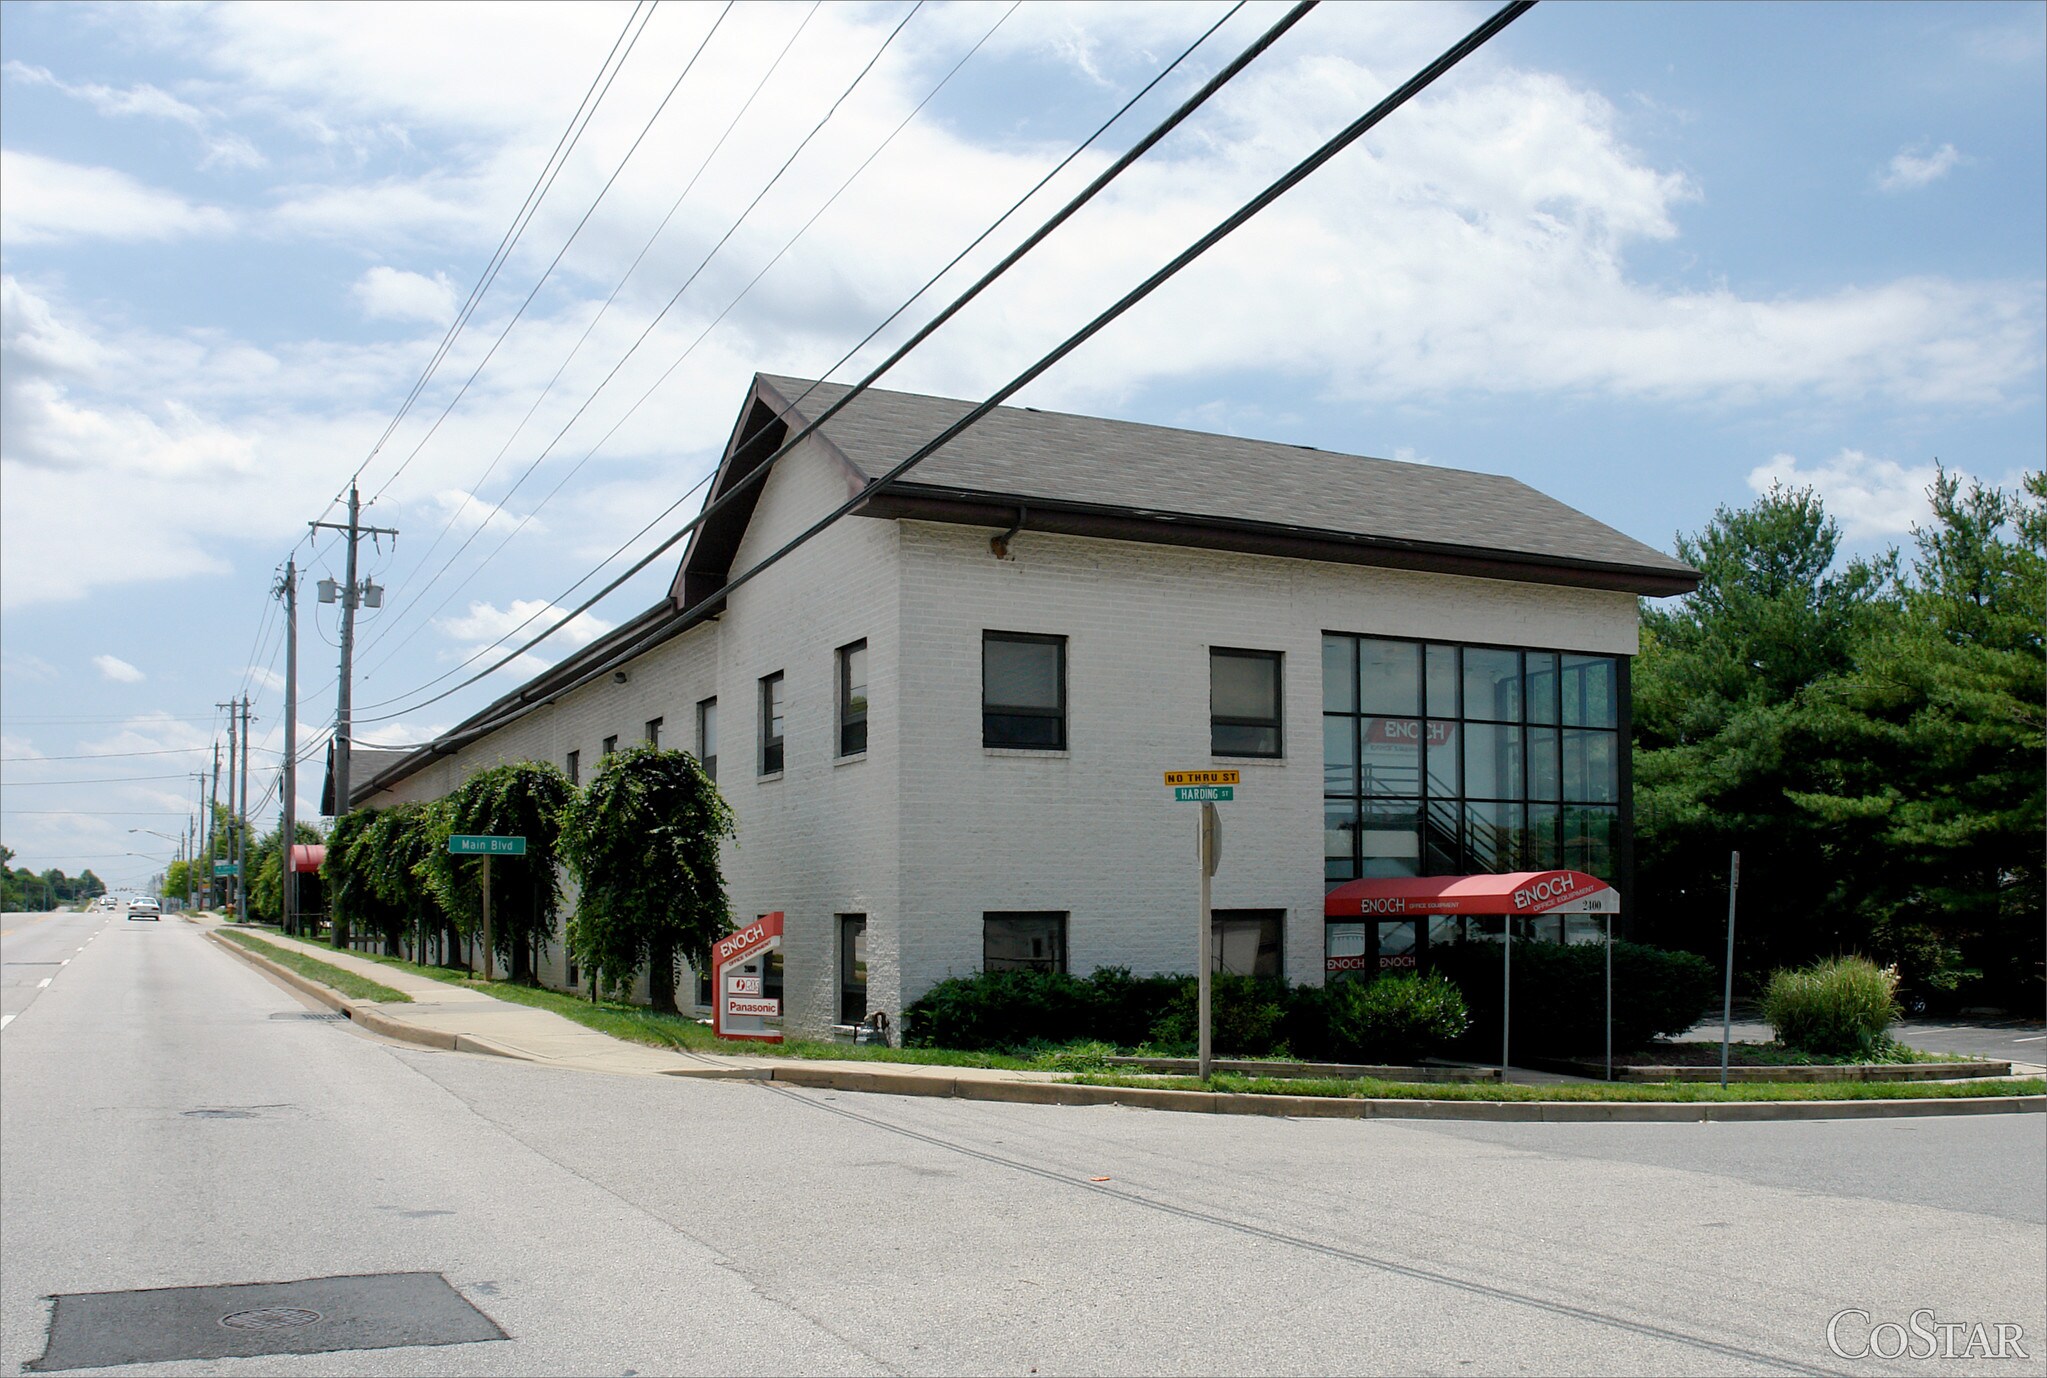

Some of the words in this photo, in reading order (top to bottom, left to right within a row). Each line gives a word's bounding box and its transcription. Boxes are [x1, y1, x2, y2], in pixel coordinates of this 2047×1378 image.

[1167, 774, 1183, 783] NO
[1188, 773, 1218, 782] THRU
[1223, 773, 1236, 781] ST
[1181, 788, 1218, 800] HARDING
[461, 839, 486, 850] Main
[491, 840, 513, 851] Blvd
[1514, 873, 1574, 909] ENOCH
[1533, 898, 1556, 912] OFFICE
[1556, 885, 1595, 903] EQUIPMENT
[1361, 897, 1405, 914] ENOCH
[1582, 900, 1602, 911] 2400
[720, 924, 765, 958] ENOCH
[1327, 958, 1365, 970] ENOCH
[1380, 956, 1416, 968] ENOCH
[730, 1001, 776, 1013] Panasonic
